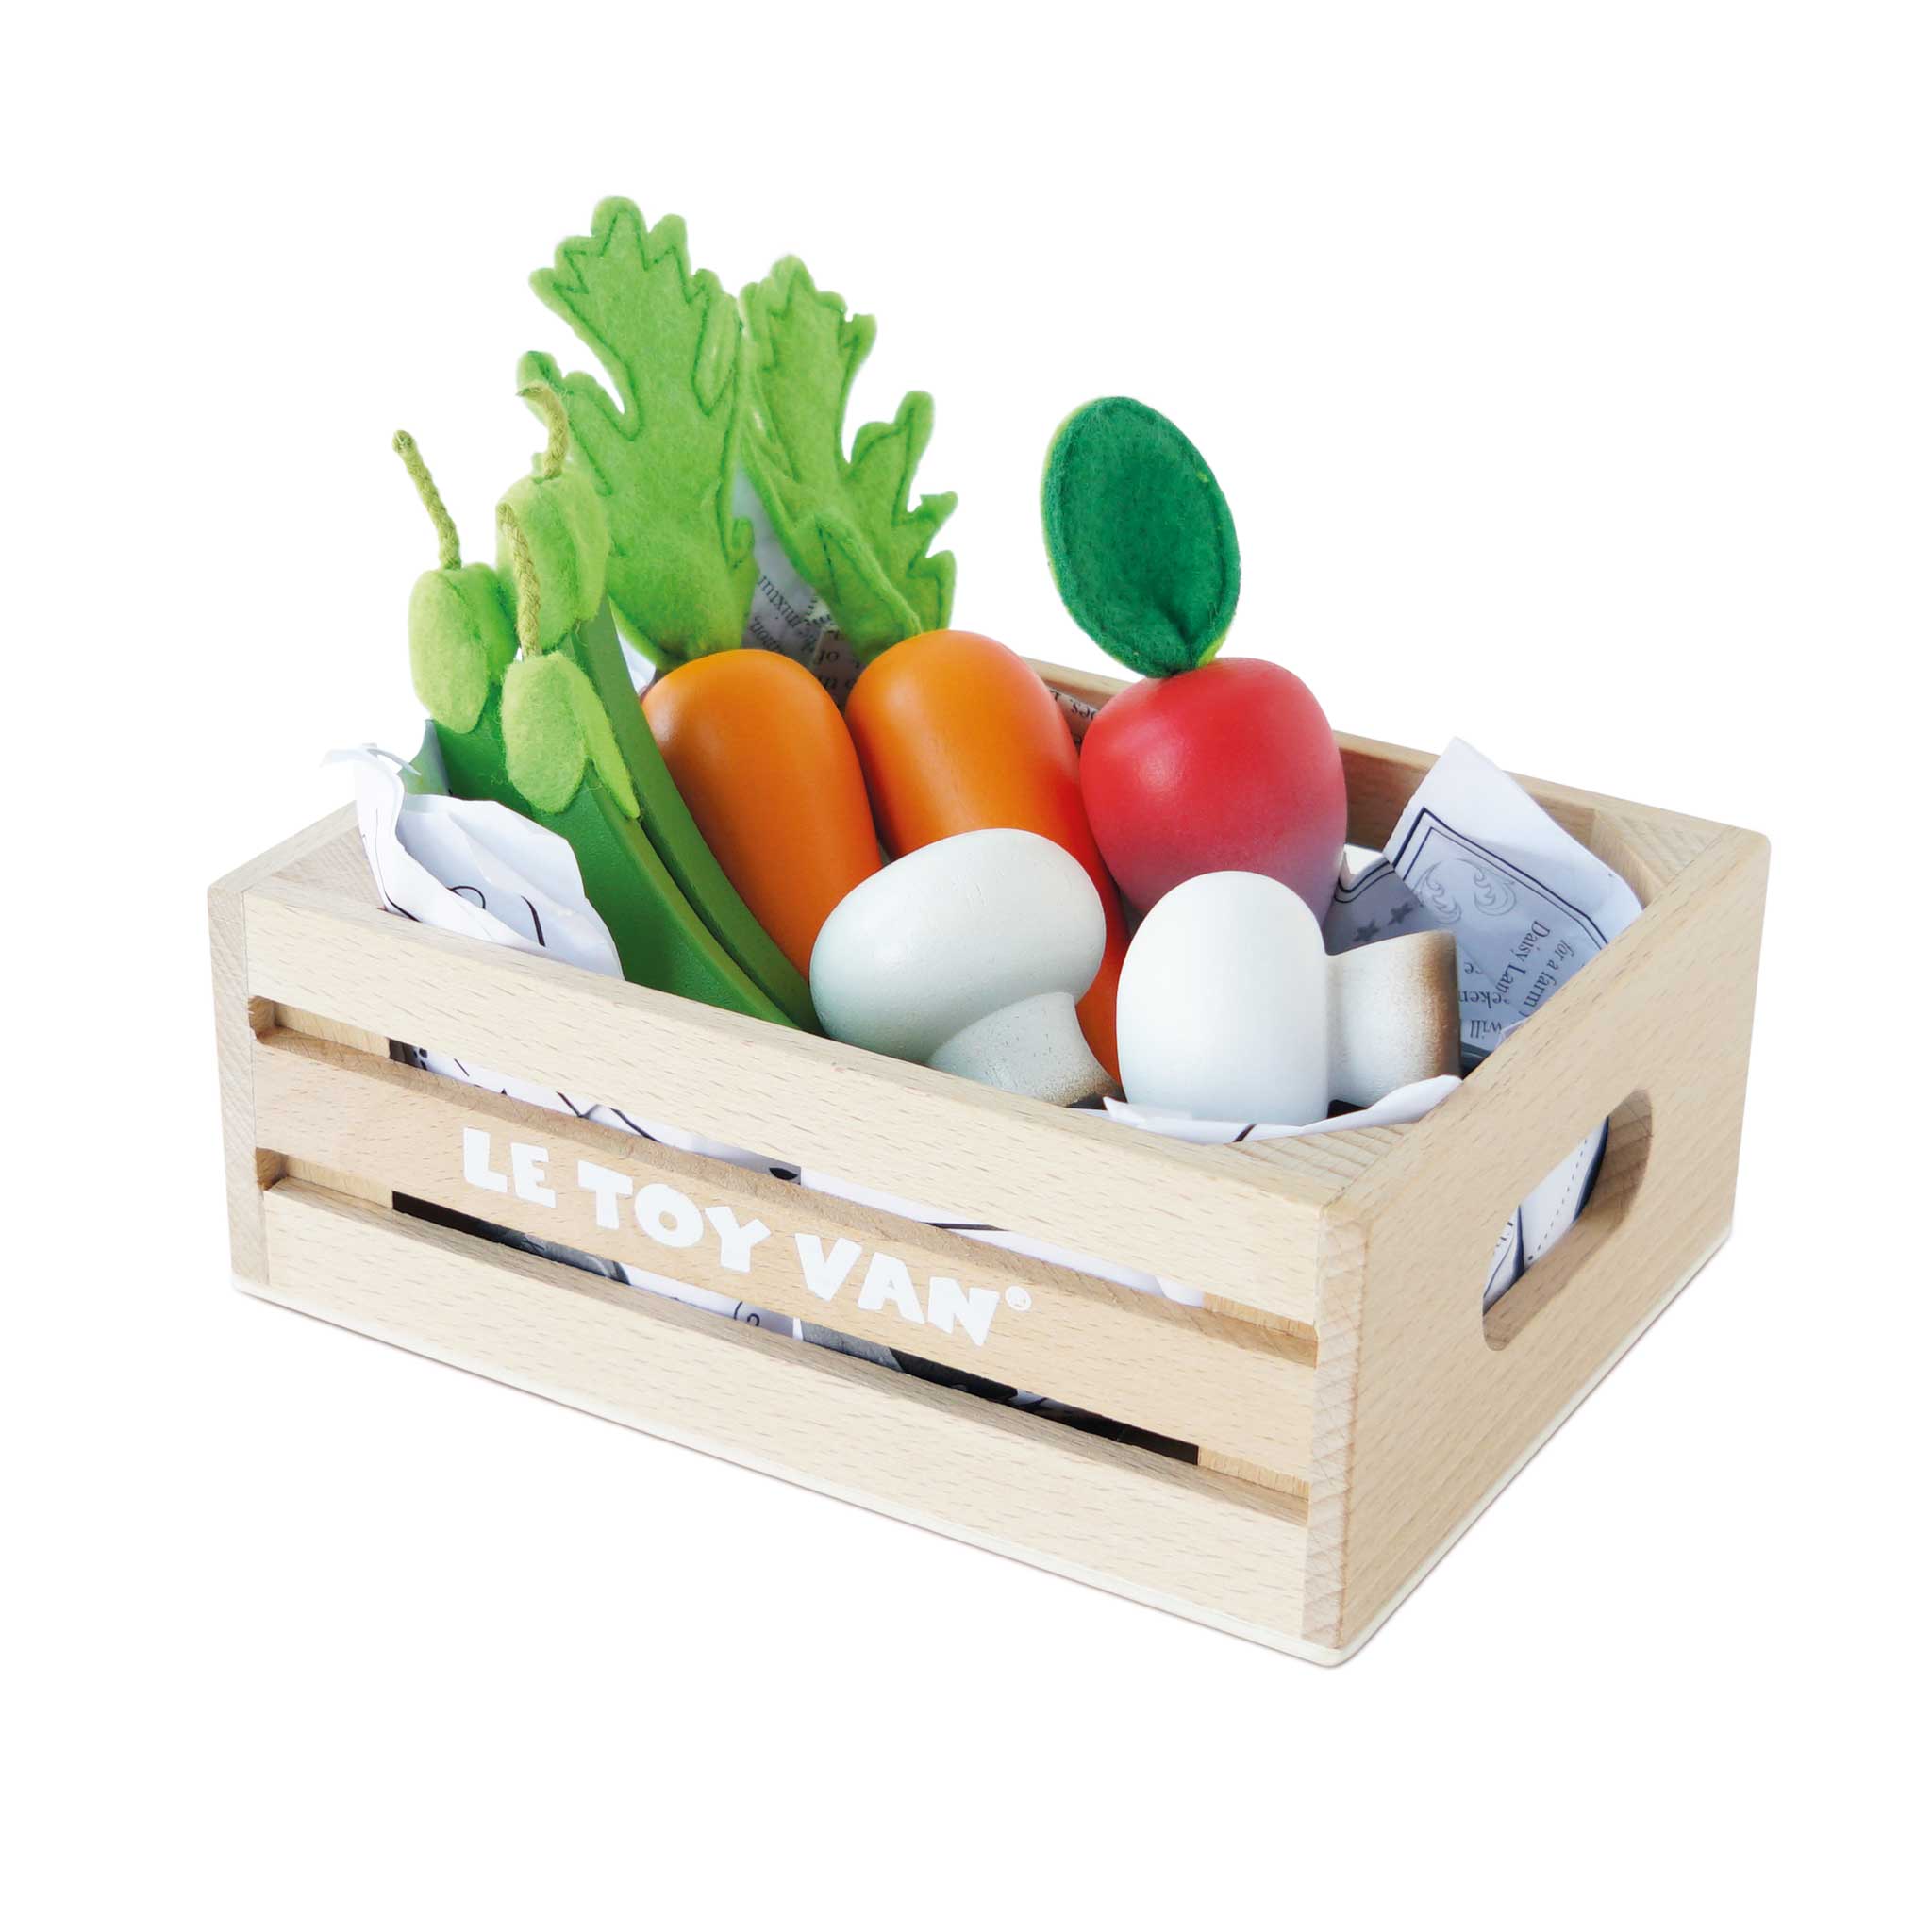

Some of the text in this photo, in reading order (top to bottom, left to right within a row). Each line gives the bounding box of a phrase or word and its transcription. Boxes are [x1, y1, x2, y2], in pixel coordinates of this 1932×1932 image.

[1509, 920, 1551, 962] Daisy
[1554, 939, 1575, 961] for
[1546, 959, 1557, 971] a
[1523, 972, 1557, 1008] farm
[1470, 1019, 1502, 1039] will
[463, 1127, 557, 1208] LE
[577, 1159, 771, 1273] TOY
